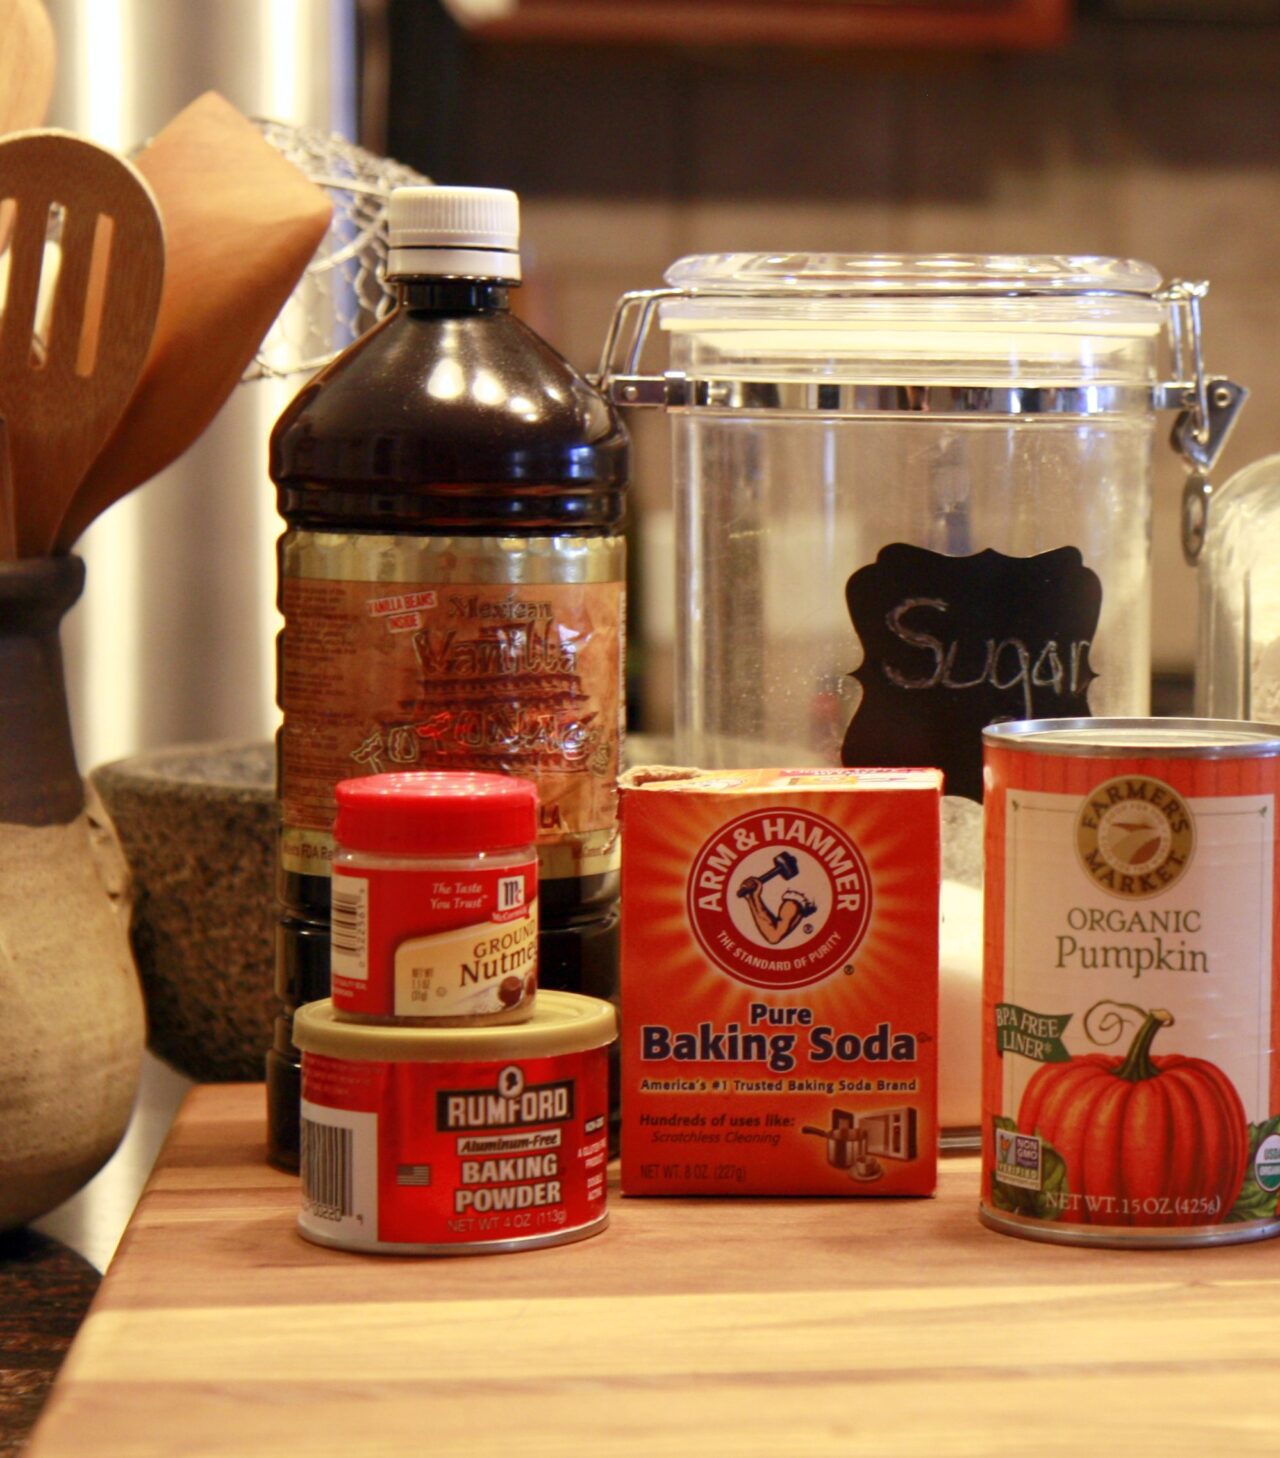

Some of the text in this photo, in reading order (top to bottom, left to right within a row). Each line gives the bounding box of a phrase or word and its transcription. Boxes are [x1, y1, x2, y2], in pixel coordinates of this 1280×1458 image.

[450, 595, 553, 620] Mexican
[413, 619, 577, 675] Vanilla
[884, 597, 1091, 720] Sugar
[1082, 781, 1189, 834] FARMER'S
[699, 817, 861, 912] ARM & HAMMER
[1085, 848, 1188, 894] MARKET
[432, 882, 483, 895] The Taste
[430, 898, 451, 910] You
[1067, 907, 1203, 934] ORGANIC
[716, 929, 842, 971] THE STANDARD OF PURITY
[1055, 935, 1210, 979] Pumpkin
[750, 1002, 812, 1025] Pure
[996, 1007, 1060, 1039] BPA FREE
[641, 1022, 917, 1072] Baking Soda
[640, 1079, 917, 1094] America's #1 Trusted Baking Soda Brand
[447, 1087, 568, 1128] RUMFORD
[640, 1114, 796, 1127] Hundreds of uses like:
[461, 1133, 560, 1153] Aluminum-Free
[652, 1131, 781, 1146] Scratchless Cleaning
[462, 1153, 558, 1184] BAKING
[640, 1164, 660, 1179] NET
[455, 1181, 561, 1213] POWDER
[1046, 1192, 1081, 1211] NET
[447, 1208, 567, 1232] NET WT 4 OZ (113g)
